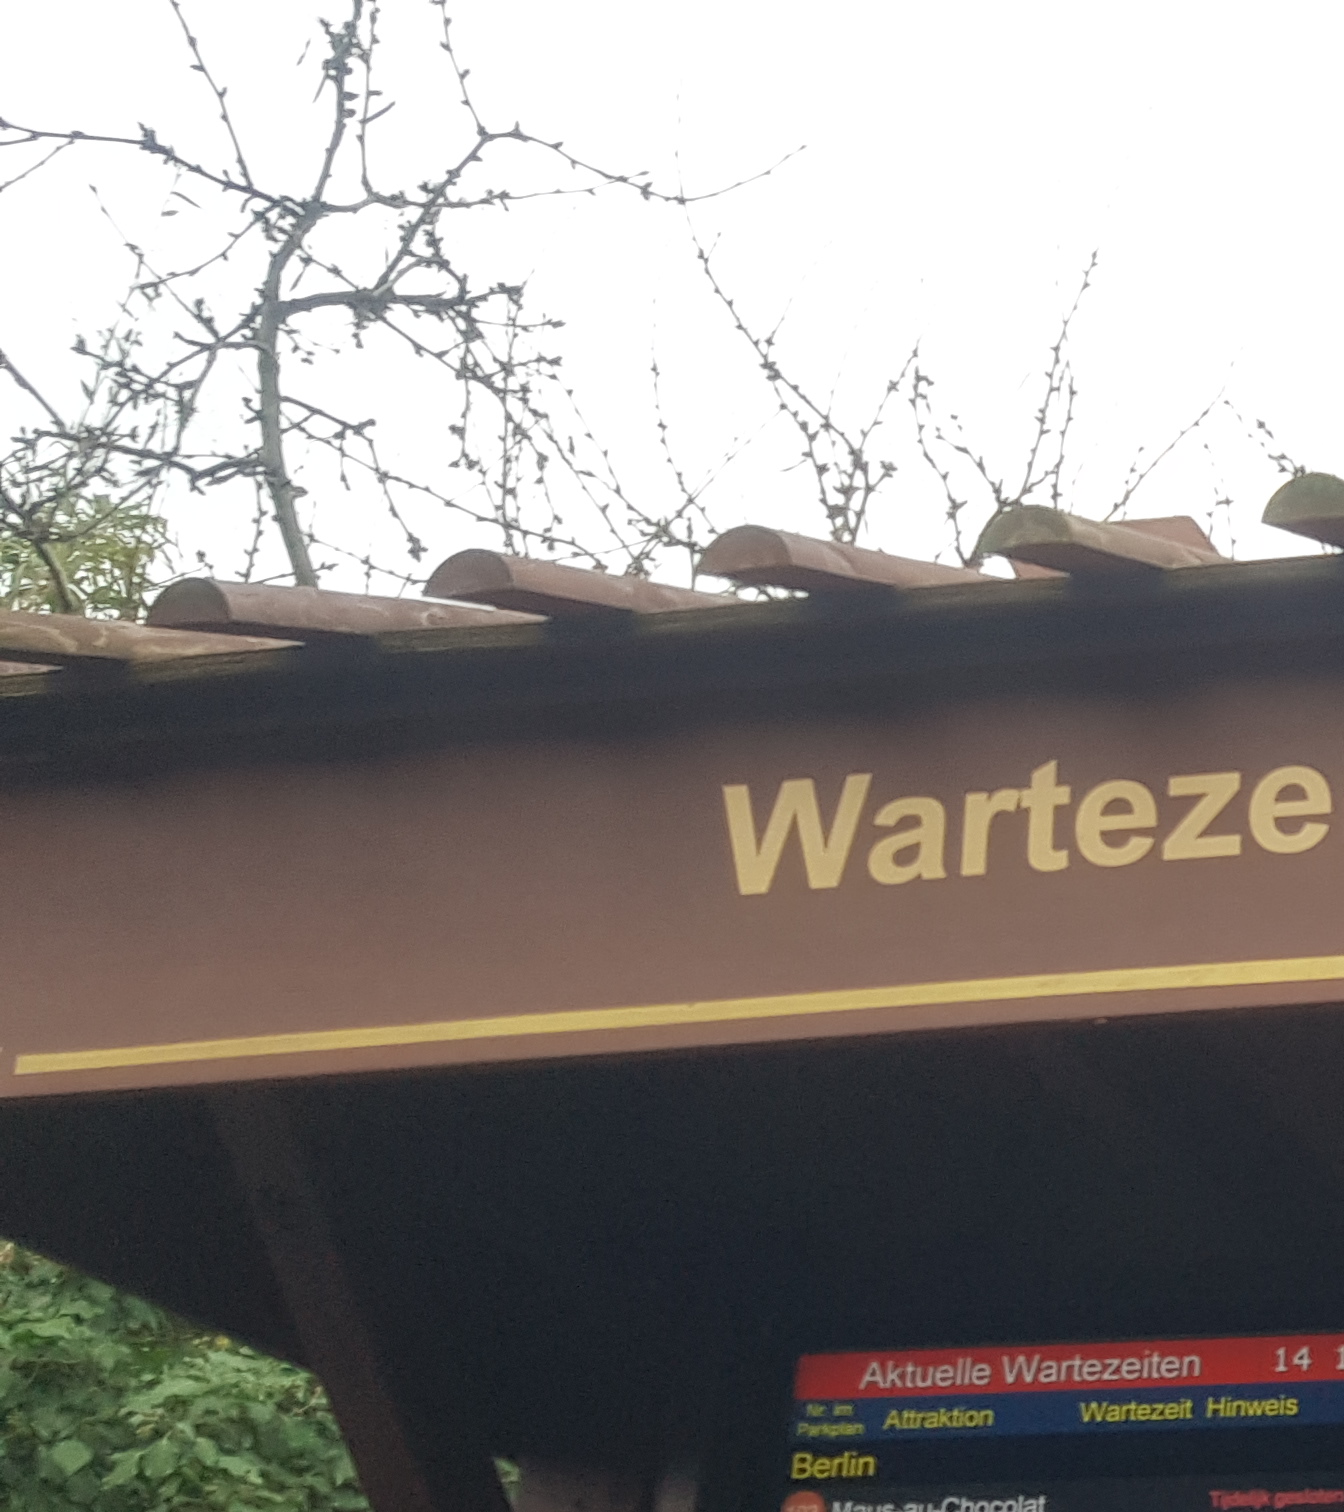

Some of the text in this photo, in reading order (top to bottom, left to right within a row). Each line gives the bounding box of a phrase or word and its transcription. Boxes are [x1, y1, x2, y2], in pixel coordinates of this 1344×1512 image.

[859, 1358, 991, 1388] Aktuelle
[1003, 1353, 1200, 1383] Wartezeiten
[1275, 1347, 1311, 1372] 14
[883, 1397, 1298, 1429] Attraktion Wartezeit Hinweis
[793, 1452, 874, 1478] Berlin
